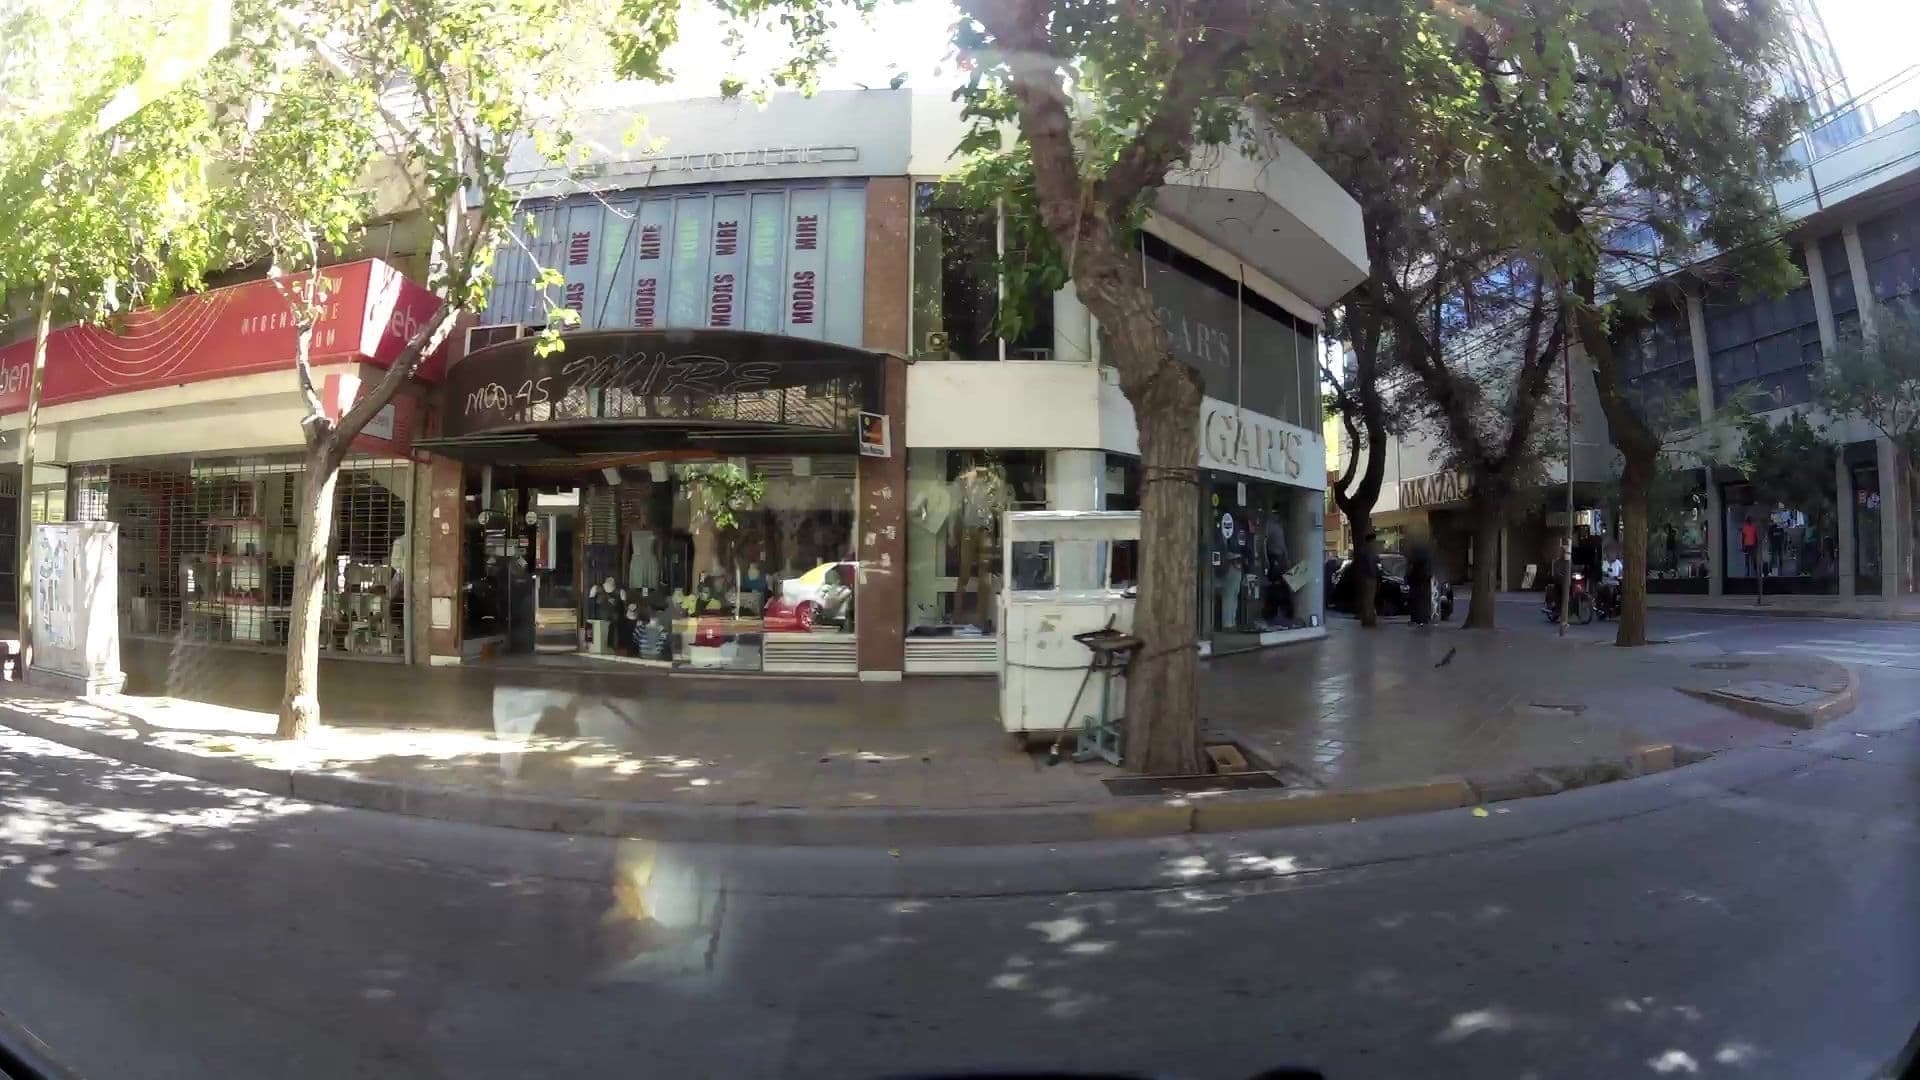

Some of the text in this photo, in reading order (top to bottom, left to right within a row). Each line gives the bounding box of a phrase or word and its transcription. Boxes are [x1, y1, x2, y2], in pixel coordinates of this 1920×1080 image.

[569, 231, 591, 266] MIRE
[633, 224, 662, 328] MODAS MIRE
[710, 220, 738, 327] MODAS MIRE
[792, 215, 818, 324] MODAS MIRE
[465, 351, 782, 415] MODAS MIRE
